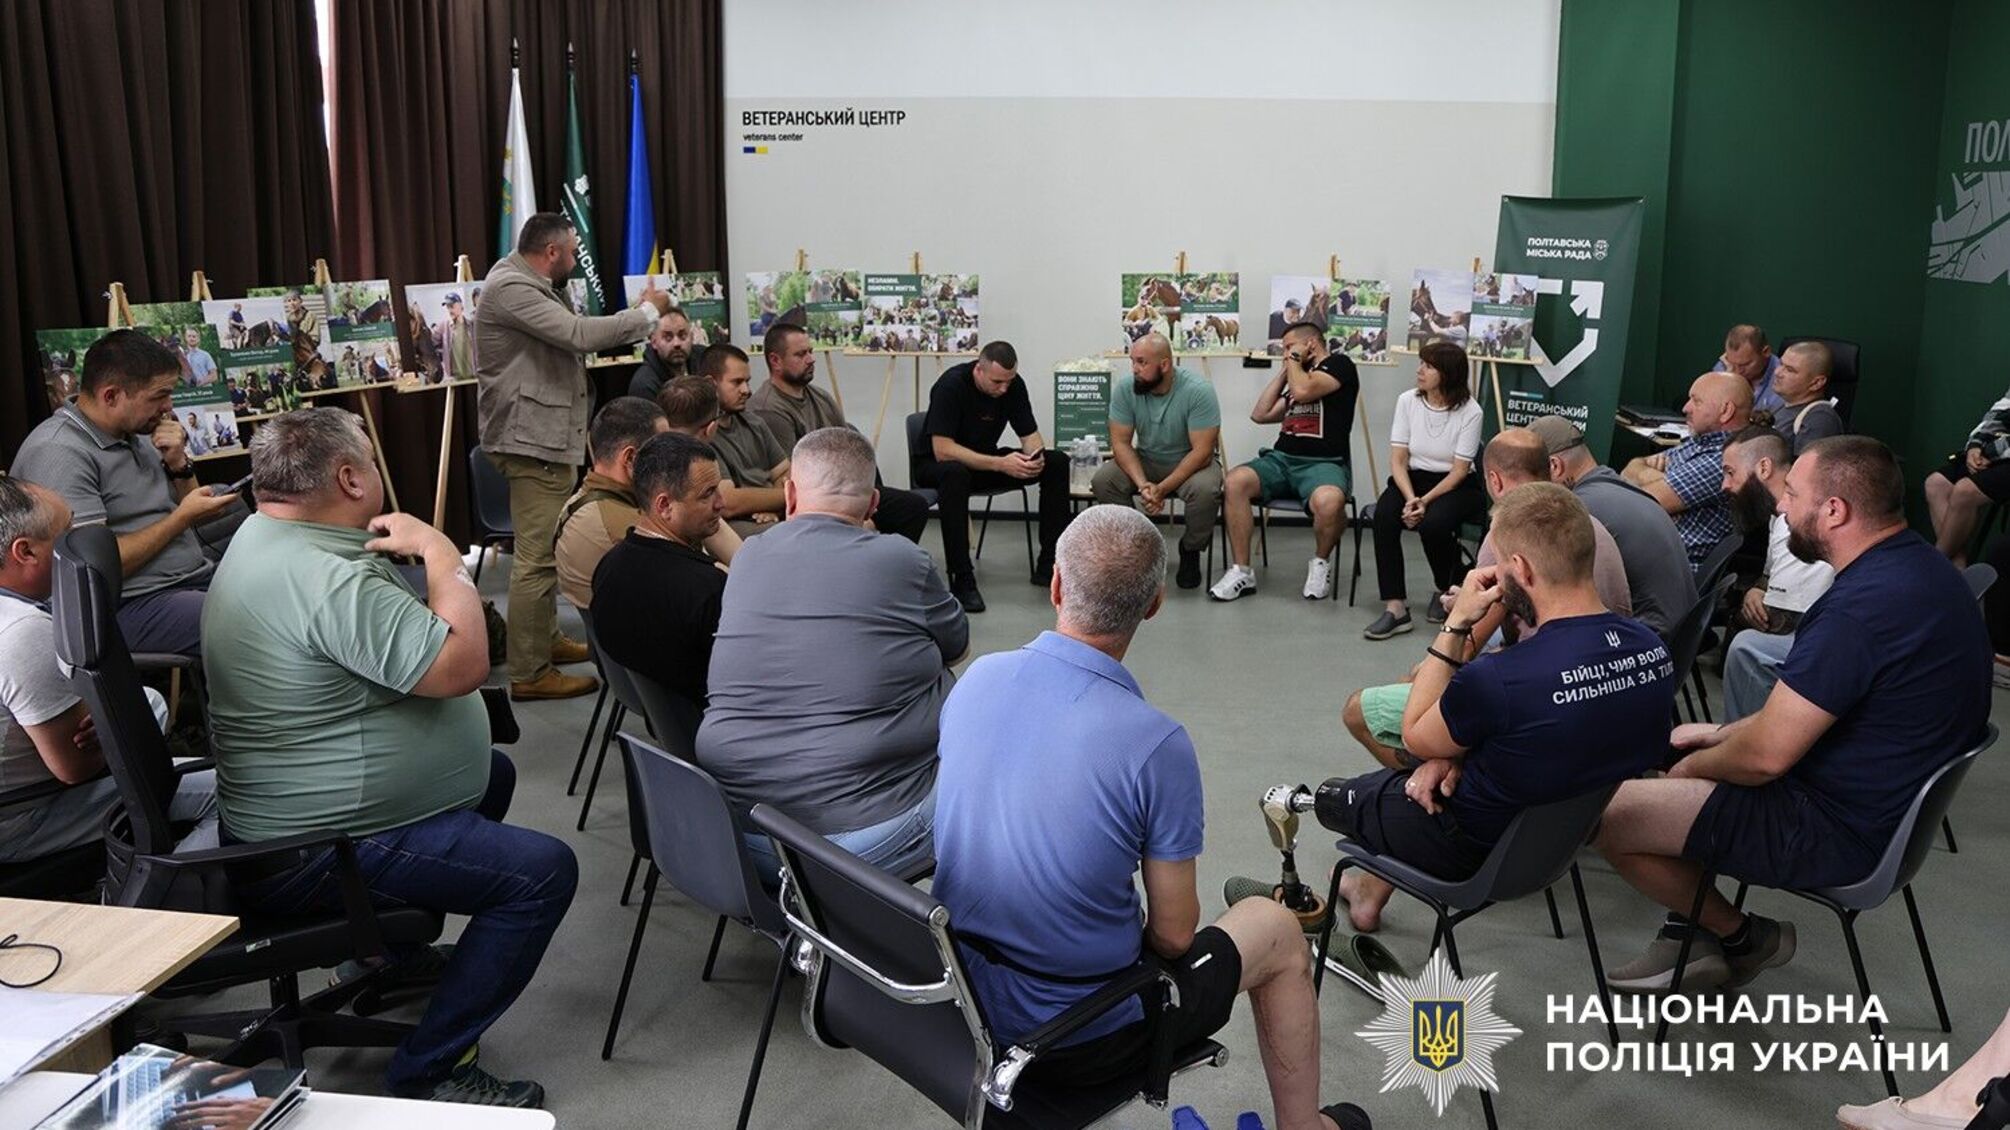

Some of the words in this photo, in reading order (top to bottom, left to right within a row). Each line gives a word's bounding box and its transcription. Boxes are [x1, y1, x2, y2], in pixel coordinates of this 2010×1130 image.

[742, 107, 855, 126] ВЕТЕРАНСЬКИЙ
[859, 110, 906, 128] ЦЕНТР
[743, 132, 777, 142] veterans
[778, 132, 804, 142] center
[1527, 237, 1592, 249] ПОЛТАВСЬКА
[1526, 248, 1563, 258] МІСЬКА
[1564, 249, 1592, 260] РАДА
[1057, 375, 1077, 383] ВОНИ
[1507, 398, 1589, 419] ВЕТЕРАНСЬКИЙ
[1561, 664, 1610, 685] БІЙЦІ,
[1609, 656, 1637, 674] ЧИЯ
[1553, 675, 1636, 705] СИЛЬНІША
[1638, 669, 1657, 684] ЗА
